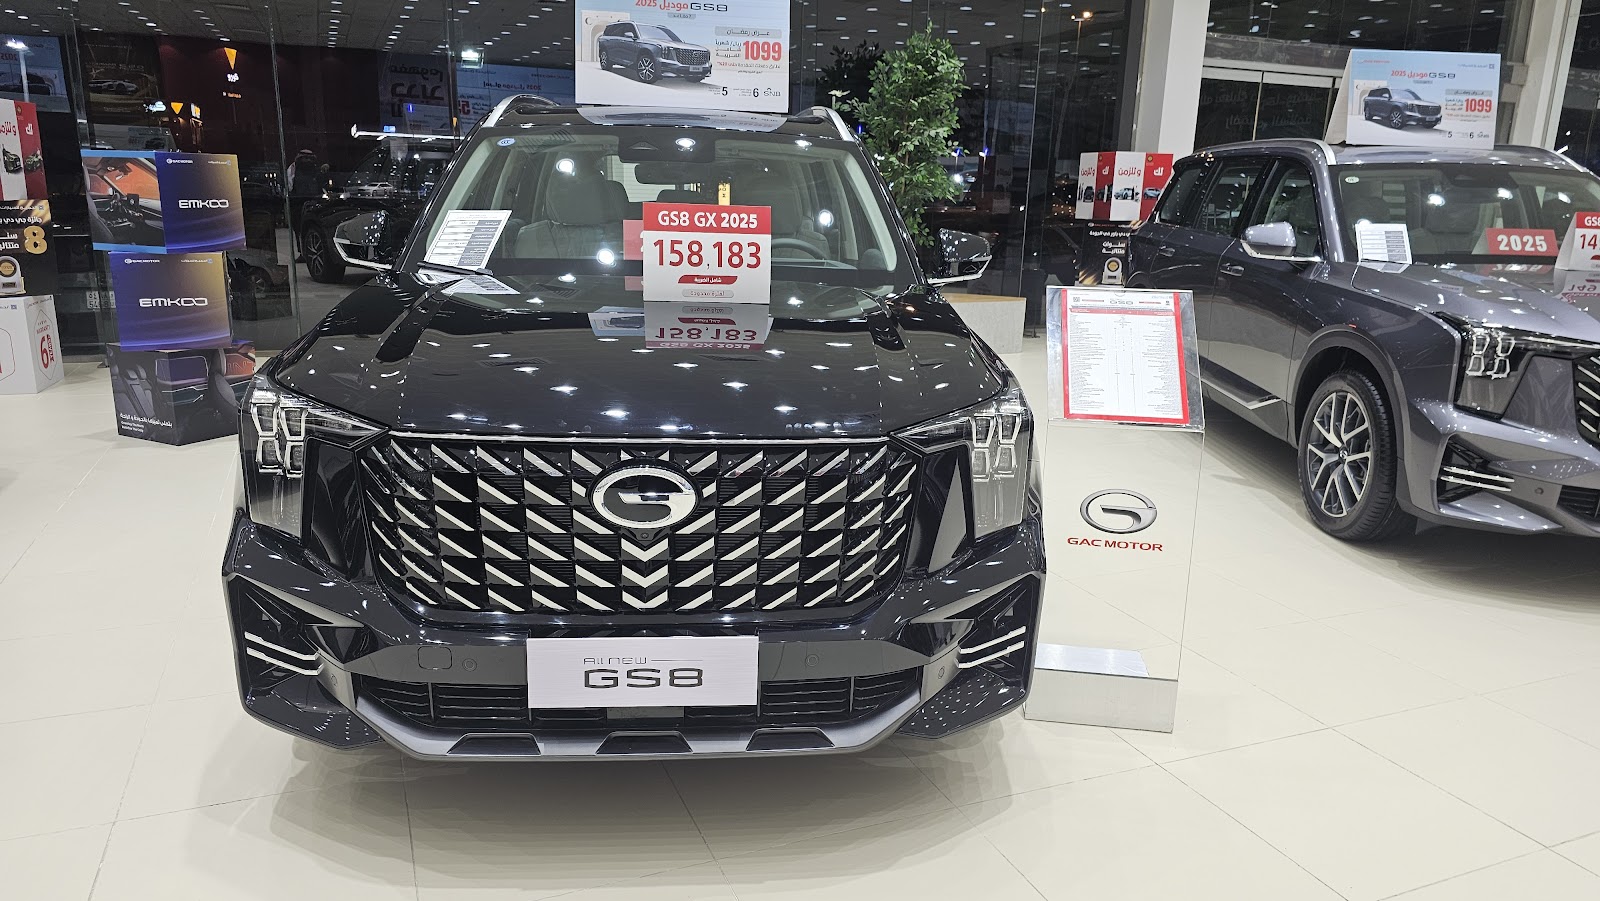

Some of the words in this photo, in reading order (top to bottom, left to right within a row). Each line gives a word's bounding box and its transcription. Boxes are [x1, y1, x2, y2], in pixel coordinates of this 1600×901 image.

[690, 2, 728, 12] GS8
[743, 40, 782, 61] 1099
[722, 86, 728, 96] 5
[753, 88, 759, 97] 6
[1465, 98, 1492, 113] 1099
[1469, 131, 1474, 139] 6
[1153, 165, 1164, 176] لك
[178, 199, 230, 209] EMKOO
[657, 210, 690, 227] GS8
[694, 212, 717, 228] GX
[720, 213, 758, 229] 2025
[23, 225, 47, 255] 8
[1497, 234, 1548, 252] 2025
[1580, 233, 1600, 250] 14
[653, 239, 762, 270] 158,183
[138, 297, 209, 308] EMKOO
[1066, 537, 1102, 547] GAC
[1104, 540, 1163, 552] MOTOR
[583, 667, 704, 689] GS8
